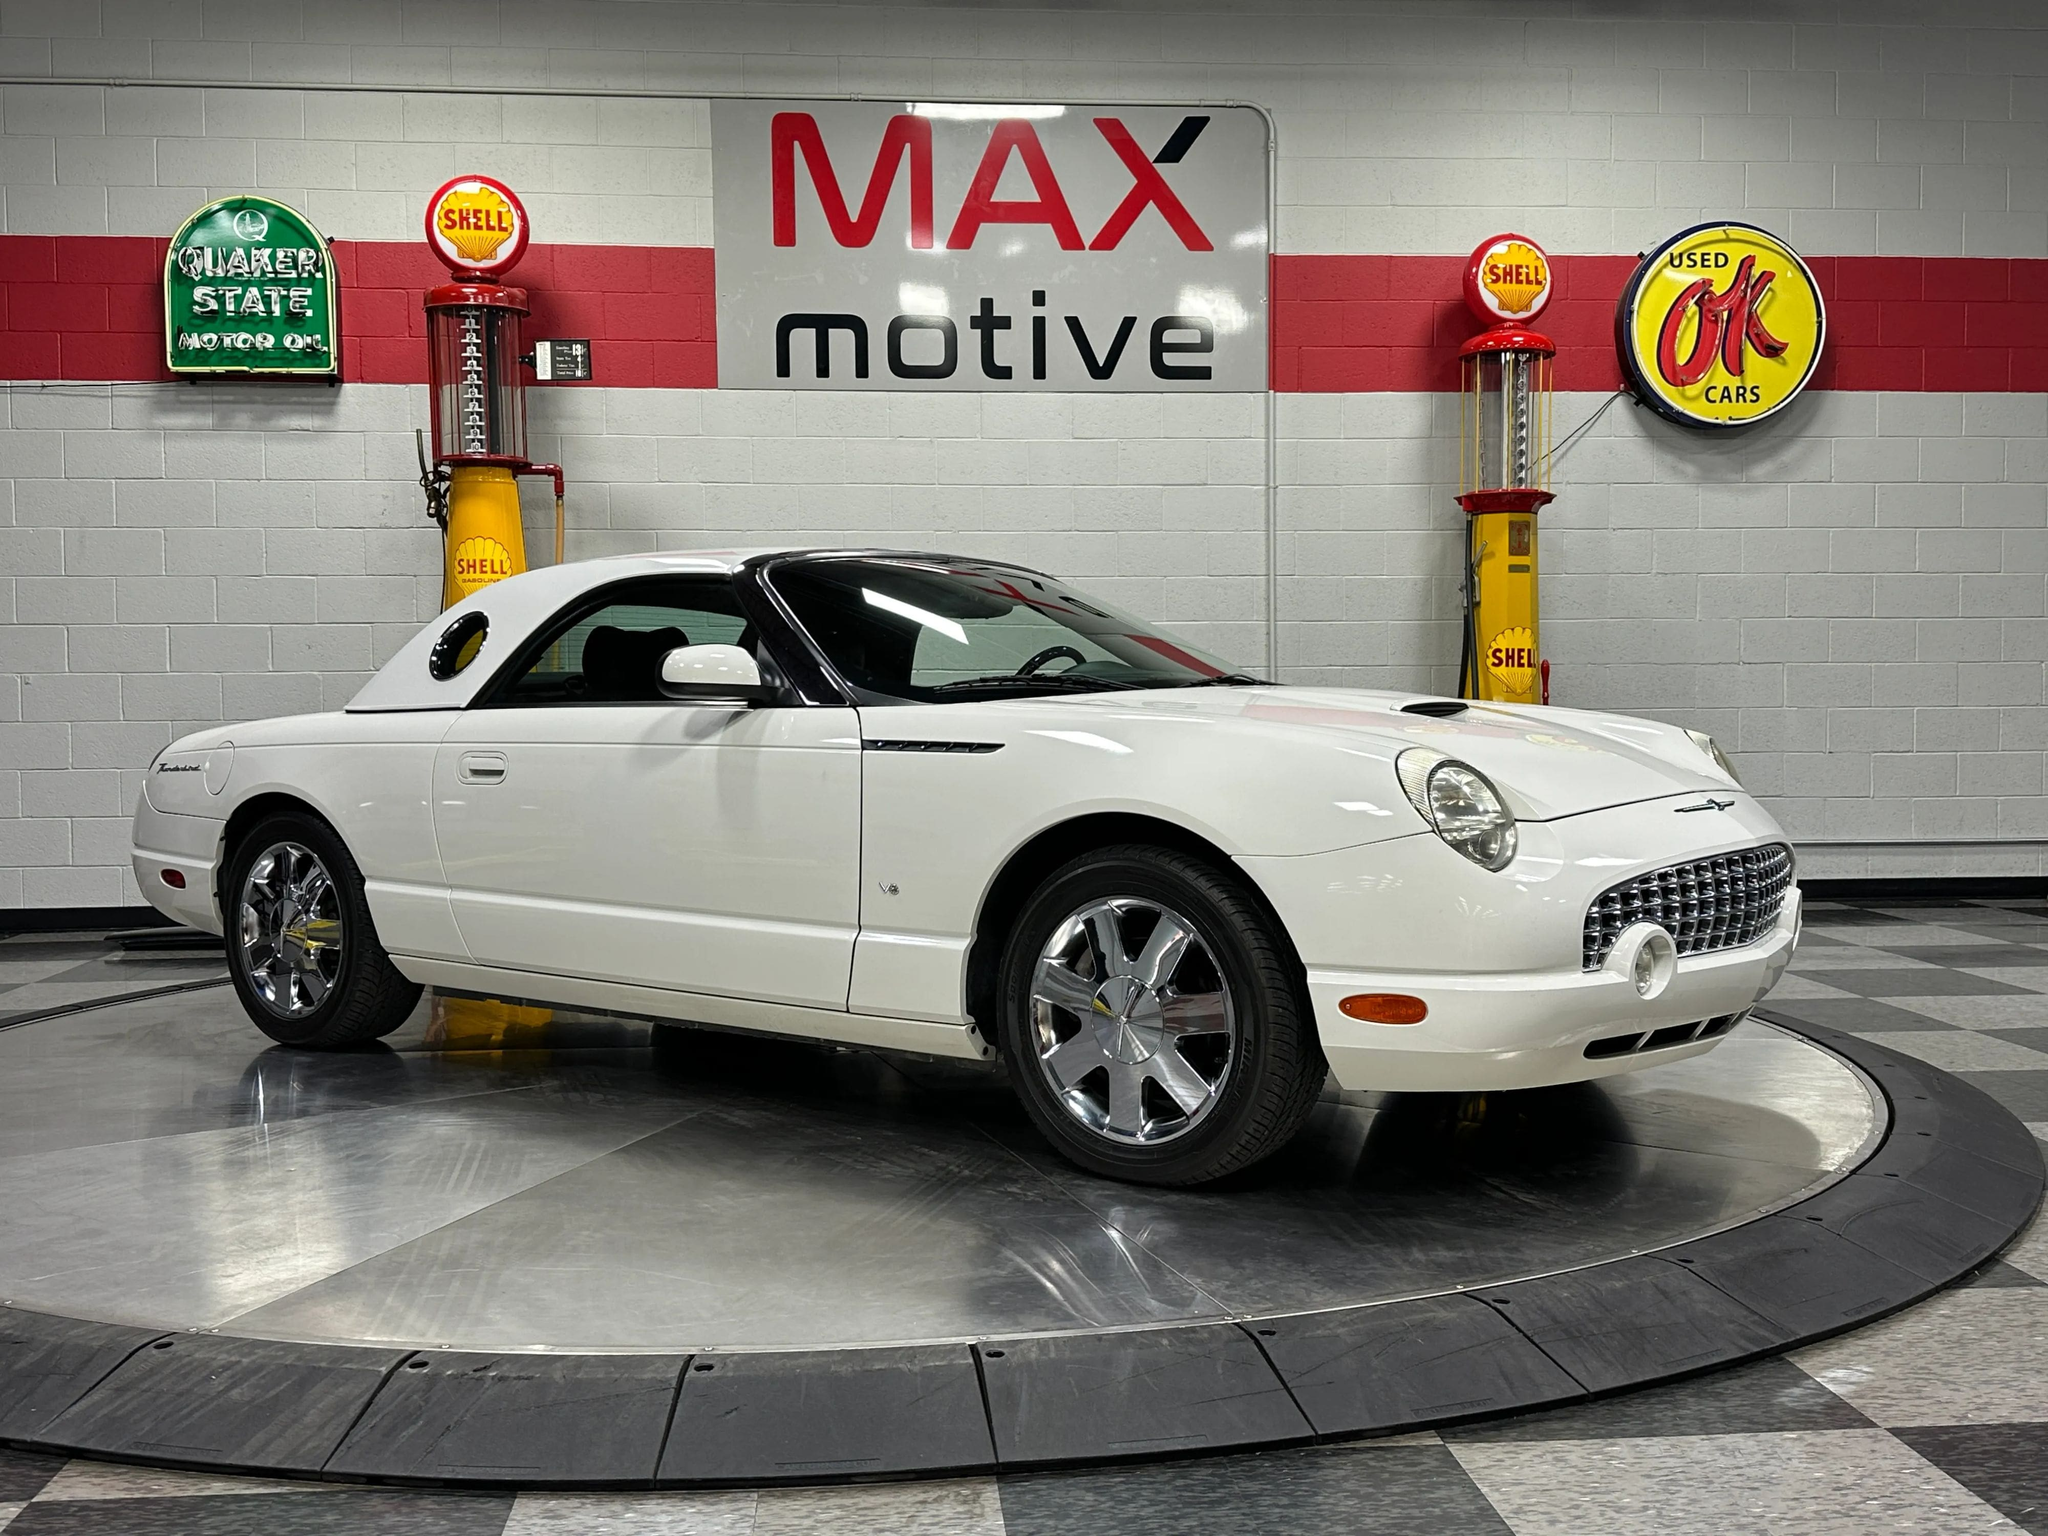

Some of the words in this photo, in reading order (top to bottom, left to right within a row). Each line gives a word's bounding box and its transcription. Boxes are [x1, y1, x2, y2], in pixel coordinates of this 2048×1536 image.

[771, 112, 1214, 251] MAX
[443, 208, 509, 233] SHELL
[178, 246, 324, 281] QUAKER
[1669, 252, 1729, 268] USED
[1488, 263, 1543, 286] SHELL
[192, 286, 314, 316] STATE
[178, 332, 275, 351] MOTOR
[283, 333, 328, 352] OIL
[775, 289, 1214, 380] motive
[1704, 386, 1760, 404] CARS
[457, 558, 508, 575] SHELL
[1491, 647, 1537, 669] SHELL
